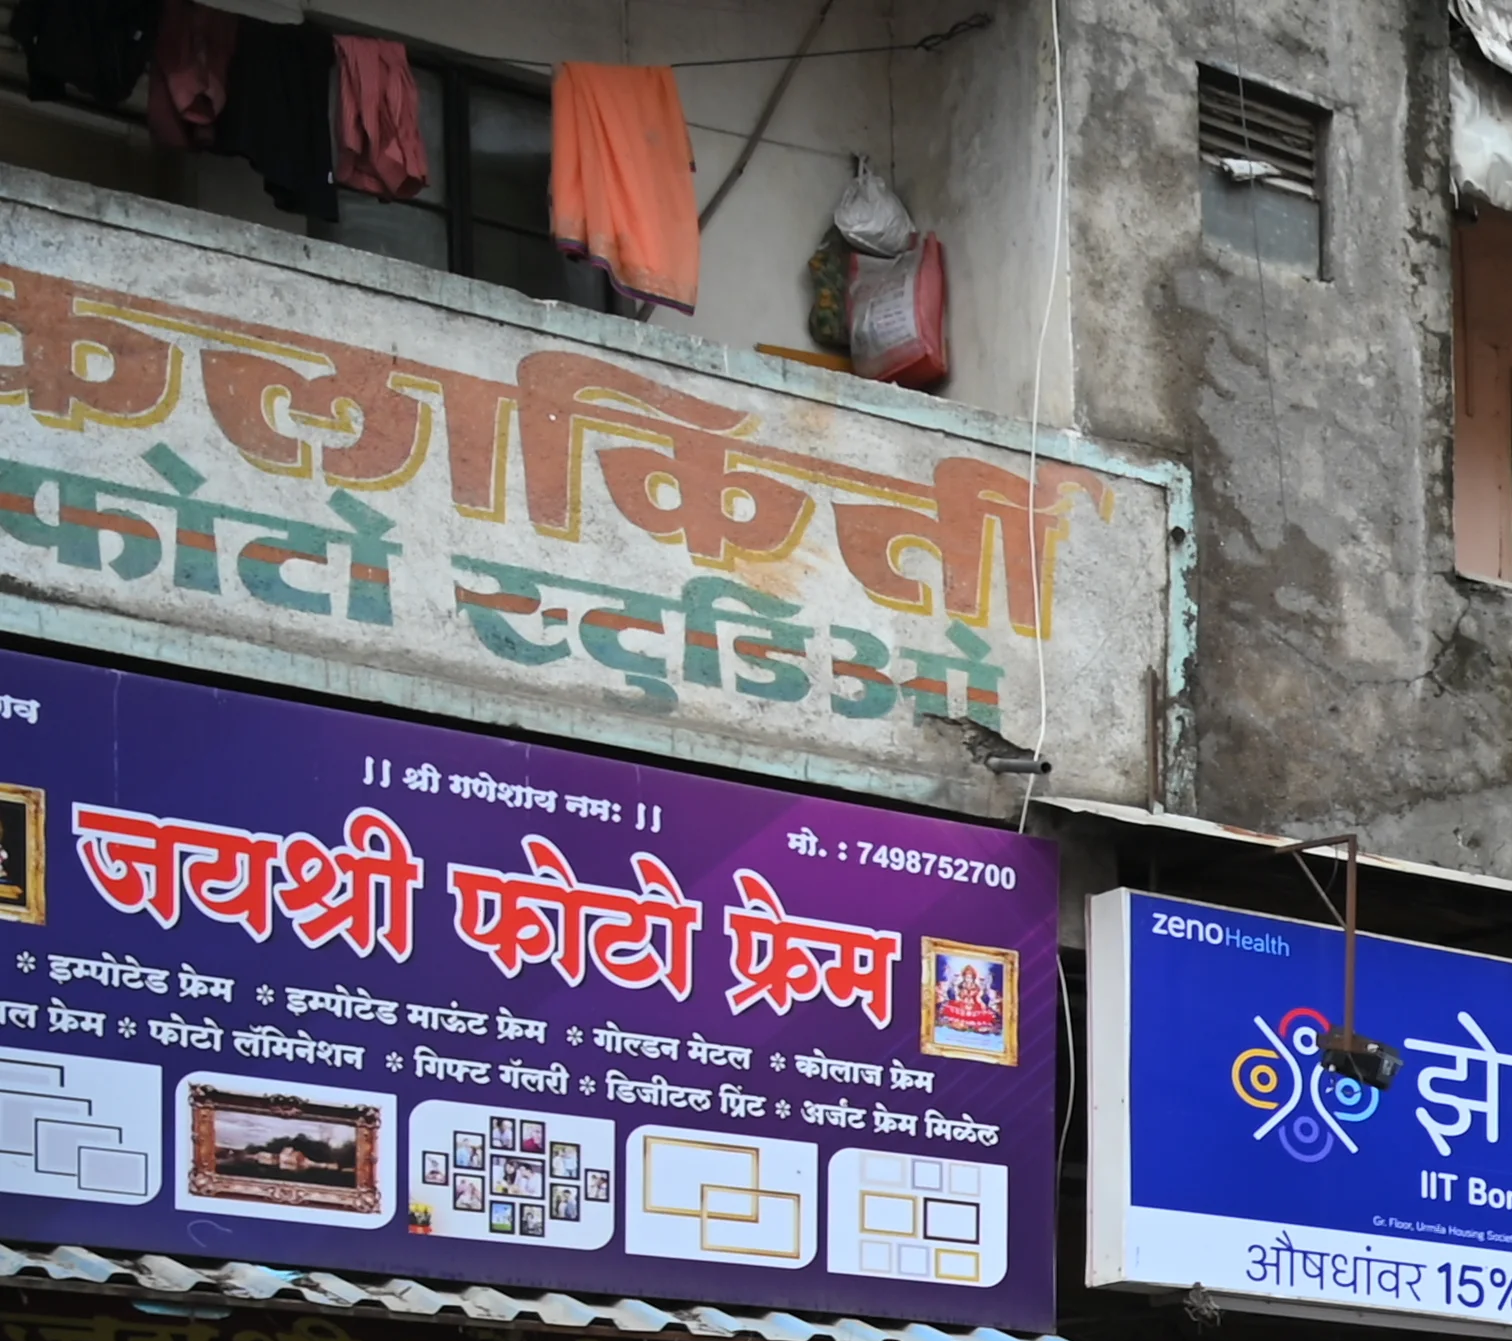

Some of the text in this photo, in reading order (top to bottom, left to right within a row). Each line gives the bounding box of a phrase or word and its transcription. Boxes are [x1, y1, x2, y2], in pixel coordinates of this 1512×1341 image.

[0, 442, 1003, 730] फोटो स्टुडिओ
[402, 763, 440, 794] श्री
[449, 771, 556, 812] गणेशाय
[565, 794, 622, 825] नमः
[857, 841, 1016, 890] 7498752700
[72, 803, 901, 1031] जयश्री फोटो फ्रेम
[48, 951, 935, 1094] इम्पोटेड फ्रेम इम्पोटेड माऊंट फ्रेम गोल्डन मेटल कोलाज फ्रेम
[47, 997, 106, 1037] फ्रेम
[149, 1013, 223, 1053] फोटो
[233, 1024, 365, 1071] लॅमिनेशन
[414, 1046, 490, 1084] गिफ्ट
[499, 1058, 569, 1096] गॅलरी
[606, 1069, 711, 1111] डिजीटल
[719, 1084, 766, 1119] प्रिंट
[801, 1098, 866, 1131] अर्जंट
[873, 1108, 917, 1138] फ्रेम
[924, 1113, 1000, 1148] मिळेल
[1420, 1170, 1458, 1201] IIT
[1246, 1230, 1427, 1300] औषधांवर
[1448, 1225, 1485, 1241] Housing
